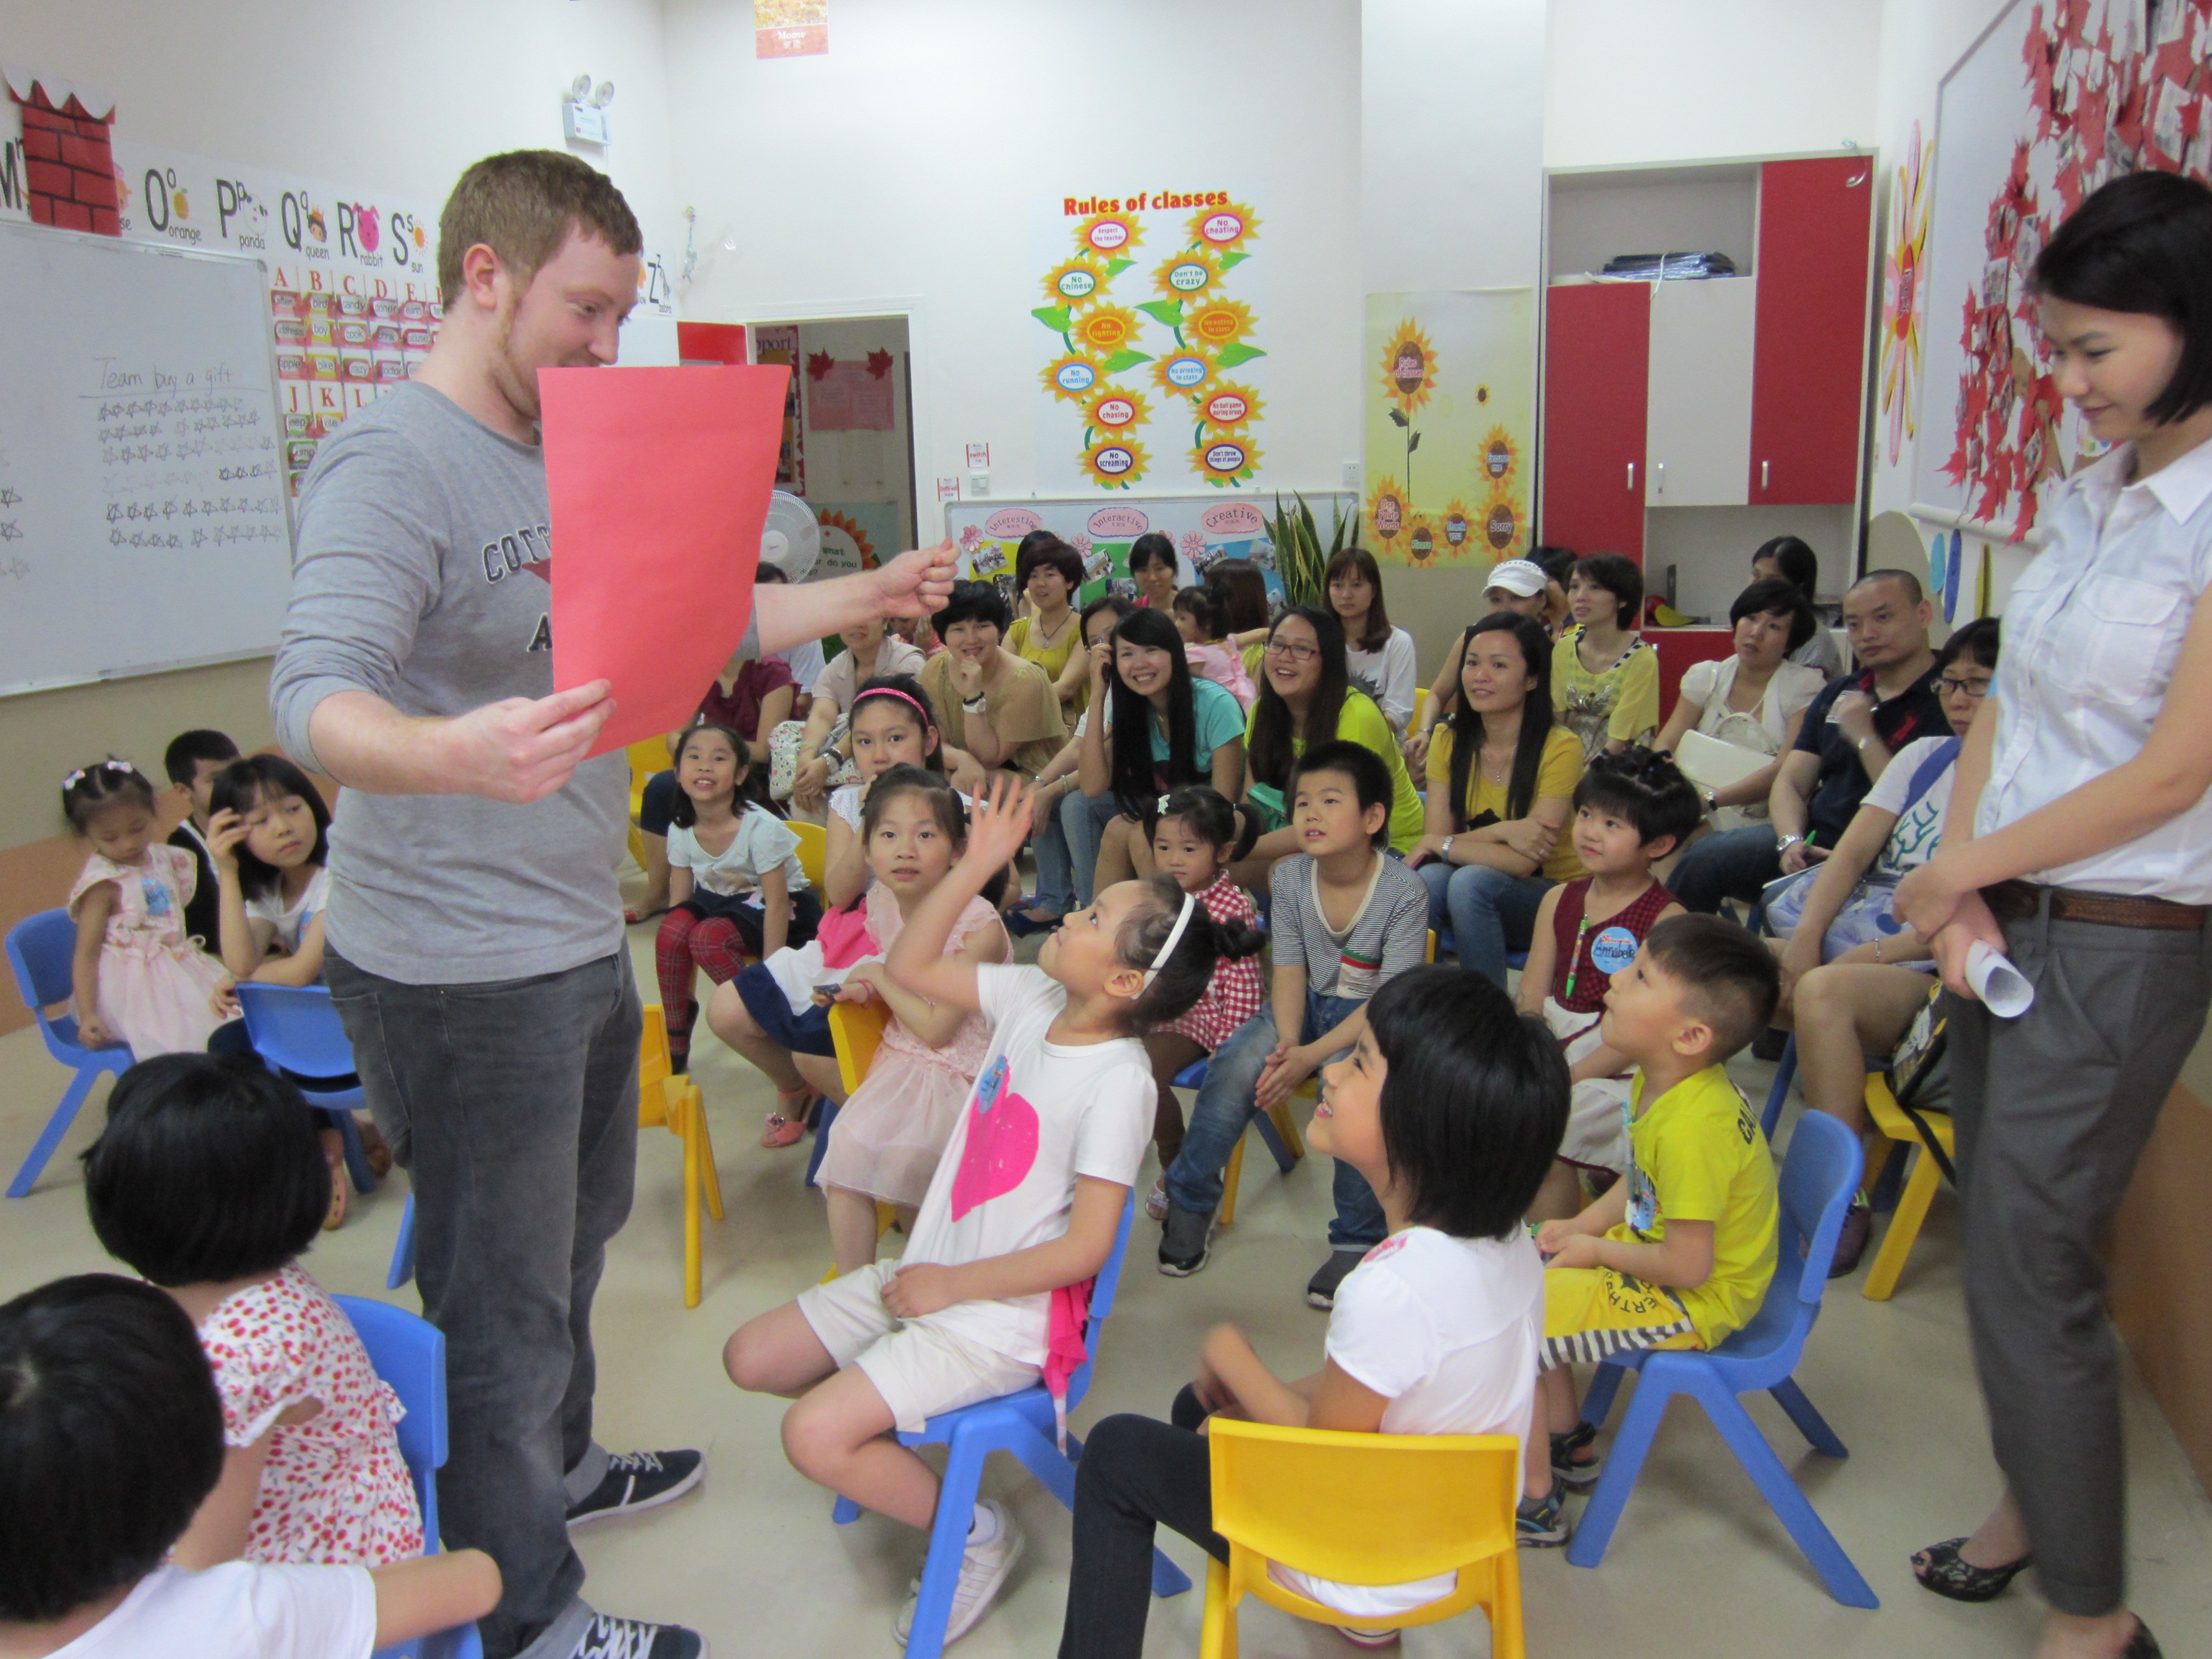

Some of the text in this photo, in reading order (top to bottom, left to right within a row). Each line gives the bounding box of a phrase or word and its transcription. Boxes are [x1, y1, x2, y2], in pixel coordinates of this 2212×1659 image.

[778, 31, 806, 40] Moose
[1064, 191, 1228, 216] Rules of classes
[1206, 226, 1239, 234] cheating
[168, 226, 202, 245] orange
[239, 234, 265, 250] panda
[306, 246, 330, 260] queen
[360, 250, 383, 268] rabbit
[411, 262, 423, 274] sun
[274, 267, 289, 288] A
[309, 270, 323, 290] B
[343, 275, 357, 295] C
[374, 279, 388, 298] D
[406, 282, 418, 301] E
[1176, 278, 1201, 286] crazy
[1399, 357, 1417, 368] Rules
[94, 357, 143, 389] Team
[186, 372, 195, 385] a
[205, 362, 233, 397] gift
[289, 387, 298, 413] J
[320, 387, 336, 407] K
[1099, 459, 1129, 468] screaming
[1487, 453, 1509, 463] Excuse
[1491, 464, 1503, 473] me
[1381, 499, 1395, 510] Use
[1206, 508, 1258, 528] Creative
[1379, 509, 1400, 520] Polite
[989, 516, 1038, 531] Interesting
[1093, 515, 1143, 531] Interactive
[1376, 521, 1400, 531] Words
[1447, 521, 1466, 532] Thank
[1490, 520, 1513, 535] Sorry
[1449, 533, 1463, 542] you
[1411, 539, 1433, 550] Please
[822, 547, 845, 556] What
[827, 559, 838, 567] do
